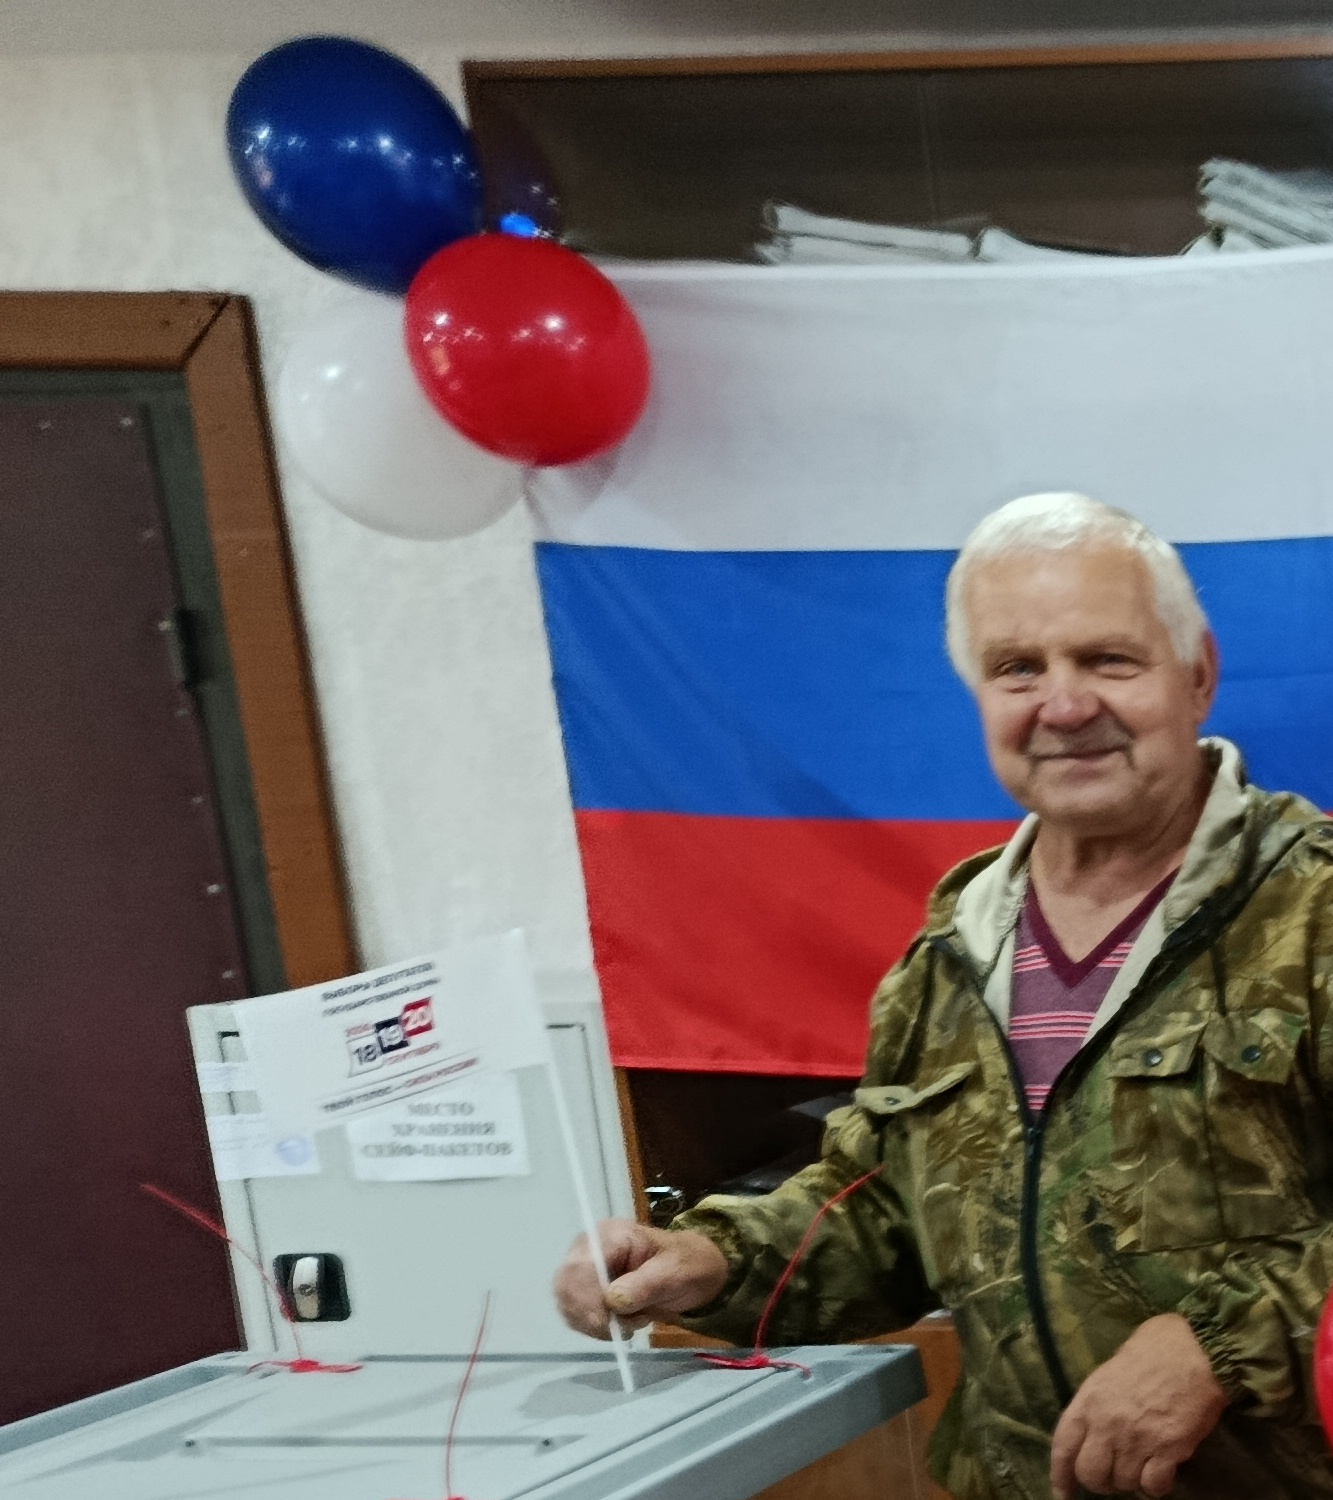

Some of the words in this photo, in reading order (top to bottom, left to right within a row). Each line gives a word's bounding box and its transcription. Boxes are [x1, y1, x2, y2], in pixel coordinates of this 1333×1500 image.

[353, 1044, 377, 1065] 18
[379, 1025, 401, 1047] 19
[402, 1006, 429, 1029] 20
[408, 1102, 475, 1116] МЕСТО
